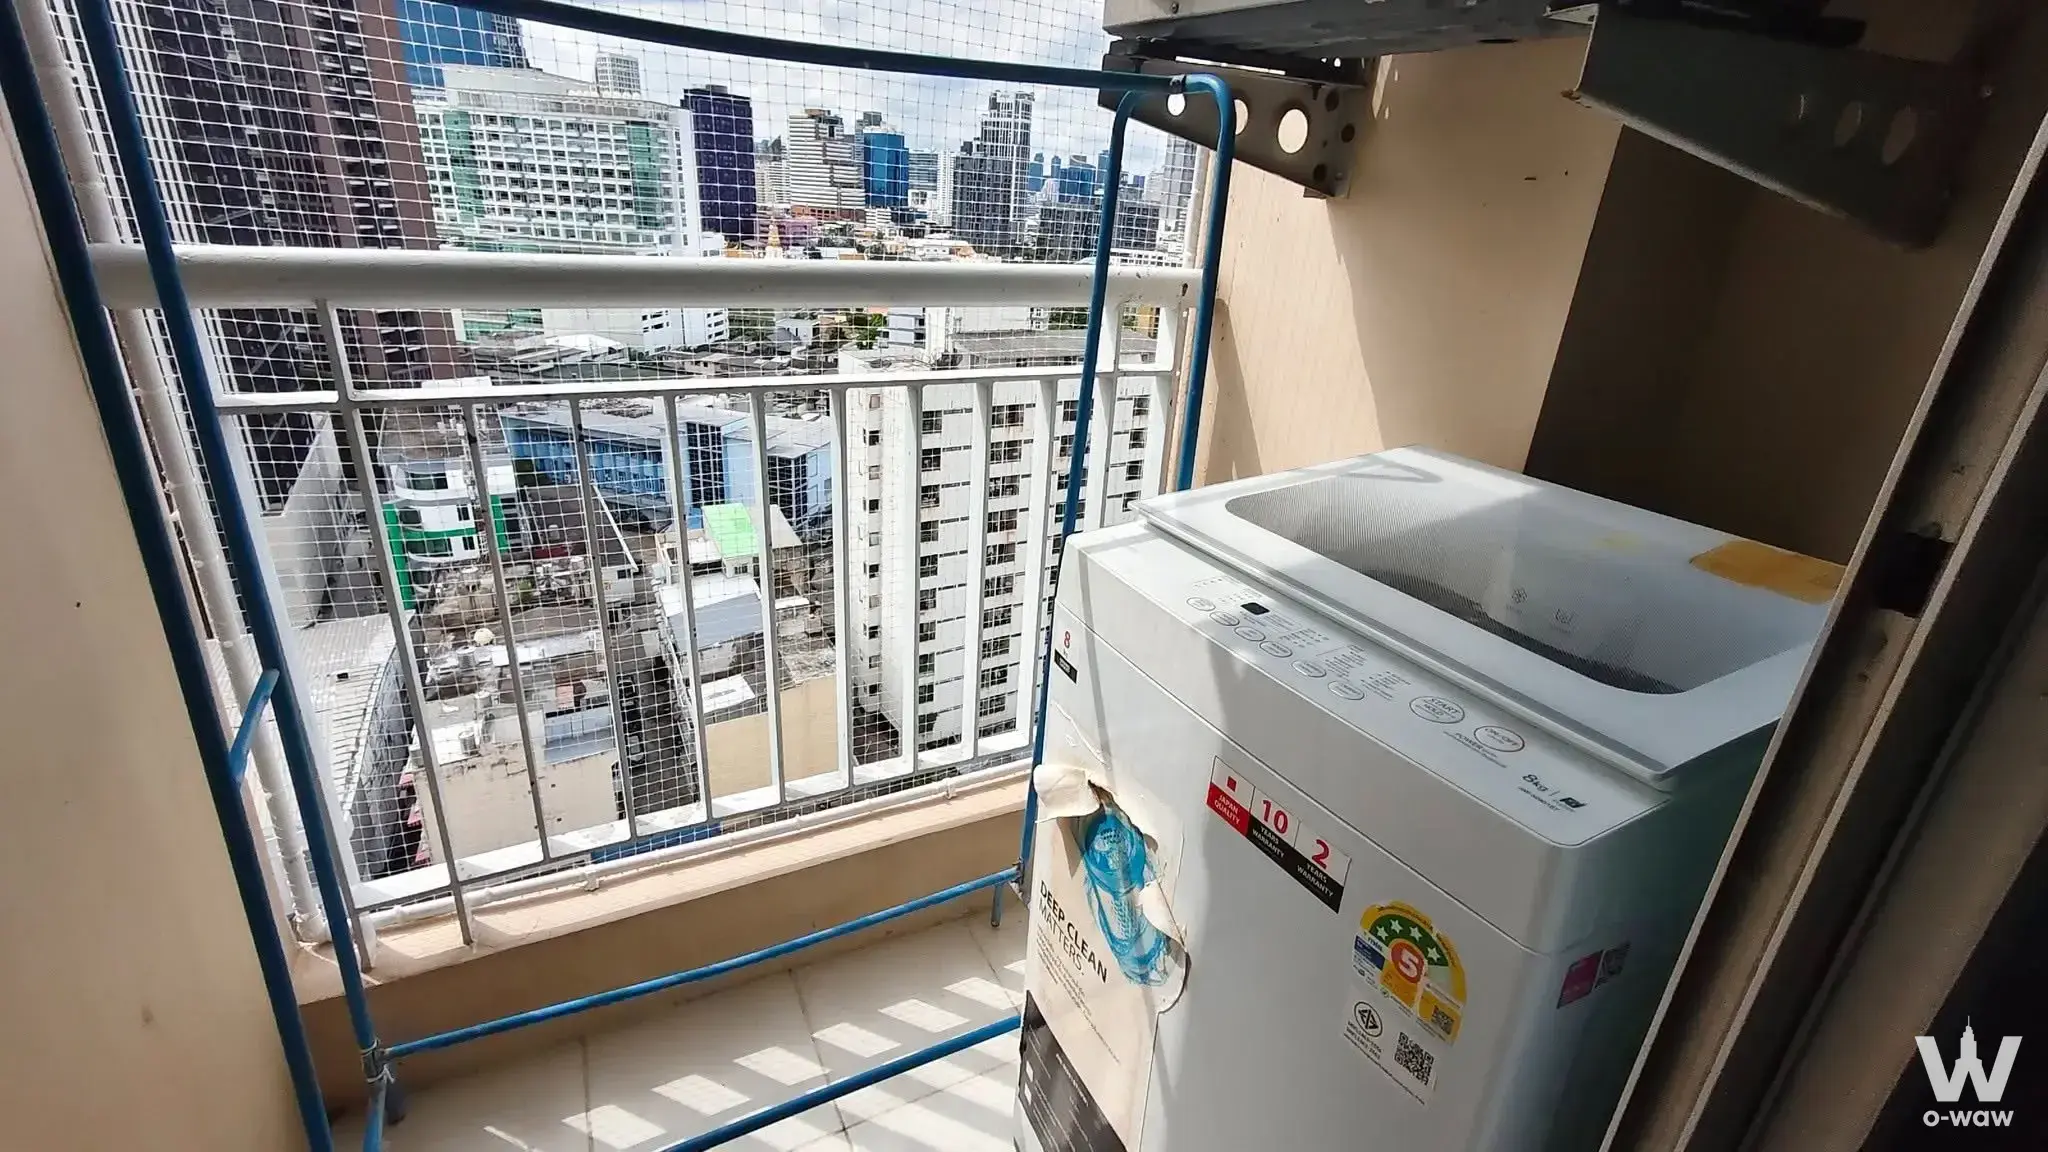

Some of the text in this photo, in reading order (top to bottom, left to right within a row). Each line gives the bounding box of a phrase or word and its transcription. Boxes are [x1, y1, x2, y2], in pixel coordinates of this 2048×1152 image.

[1214, 799, 1241, 825] QUALITY
[1218, 794, 1239, 815] JAPAN
[1262, 799, 1289, 834] 10
[1252, 828, 1285, 859] WARRANTY
[1260, 826, 1280, 845] YEARS
[1311, 838, 1330, 870] 2
[1297, 864, 1334, 898] WARRANTY
[1306, 862, 1328, 884] YEARS
[1040, 880, 1108, 984] DEEP CLEAN
[1398, 947, 1420, 978] 5
